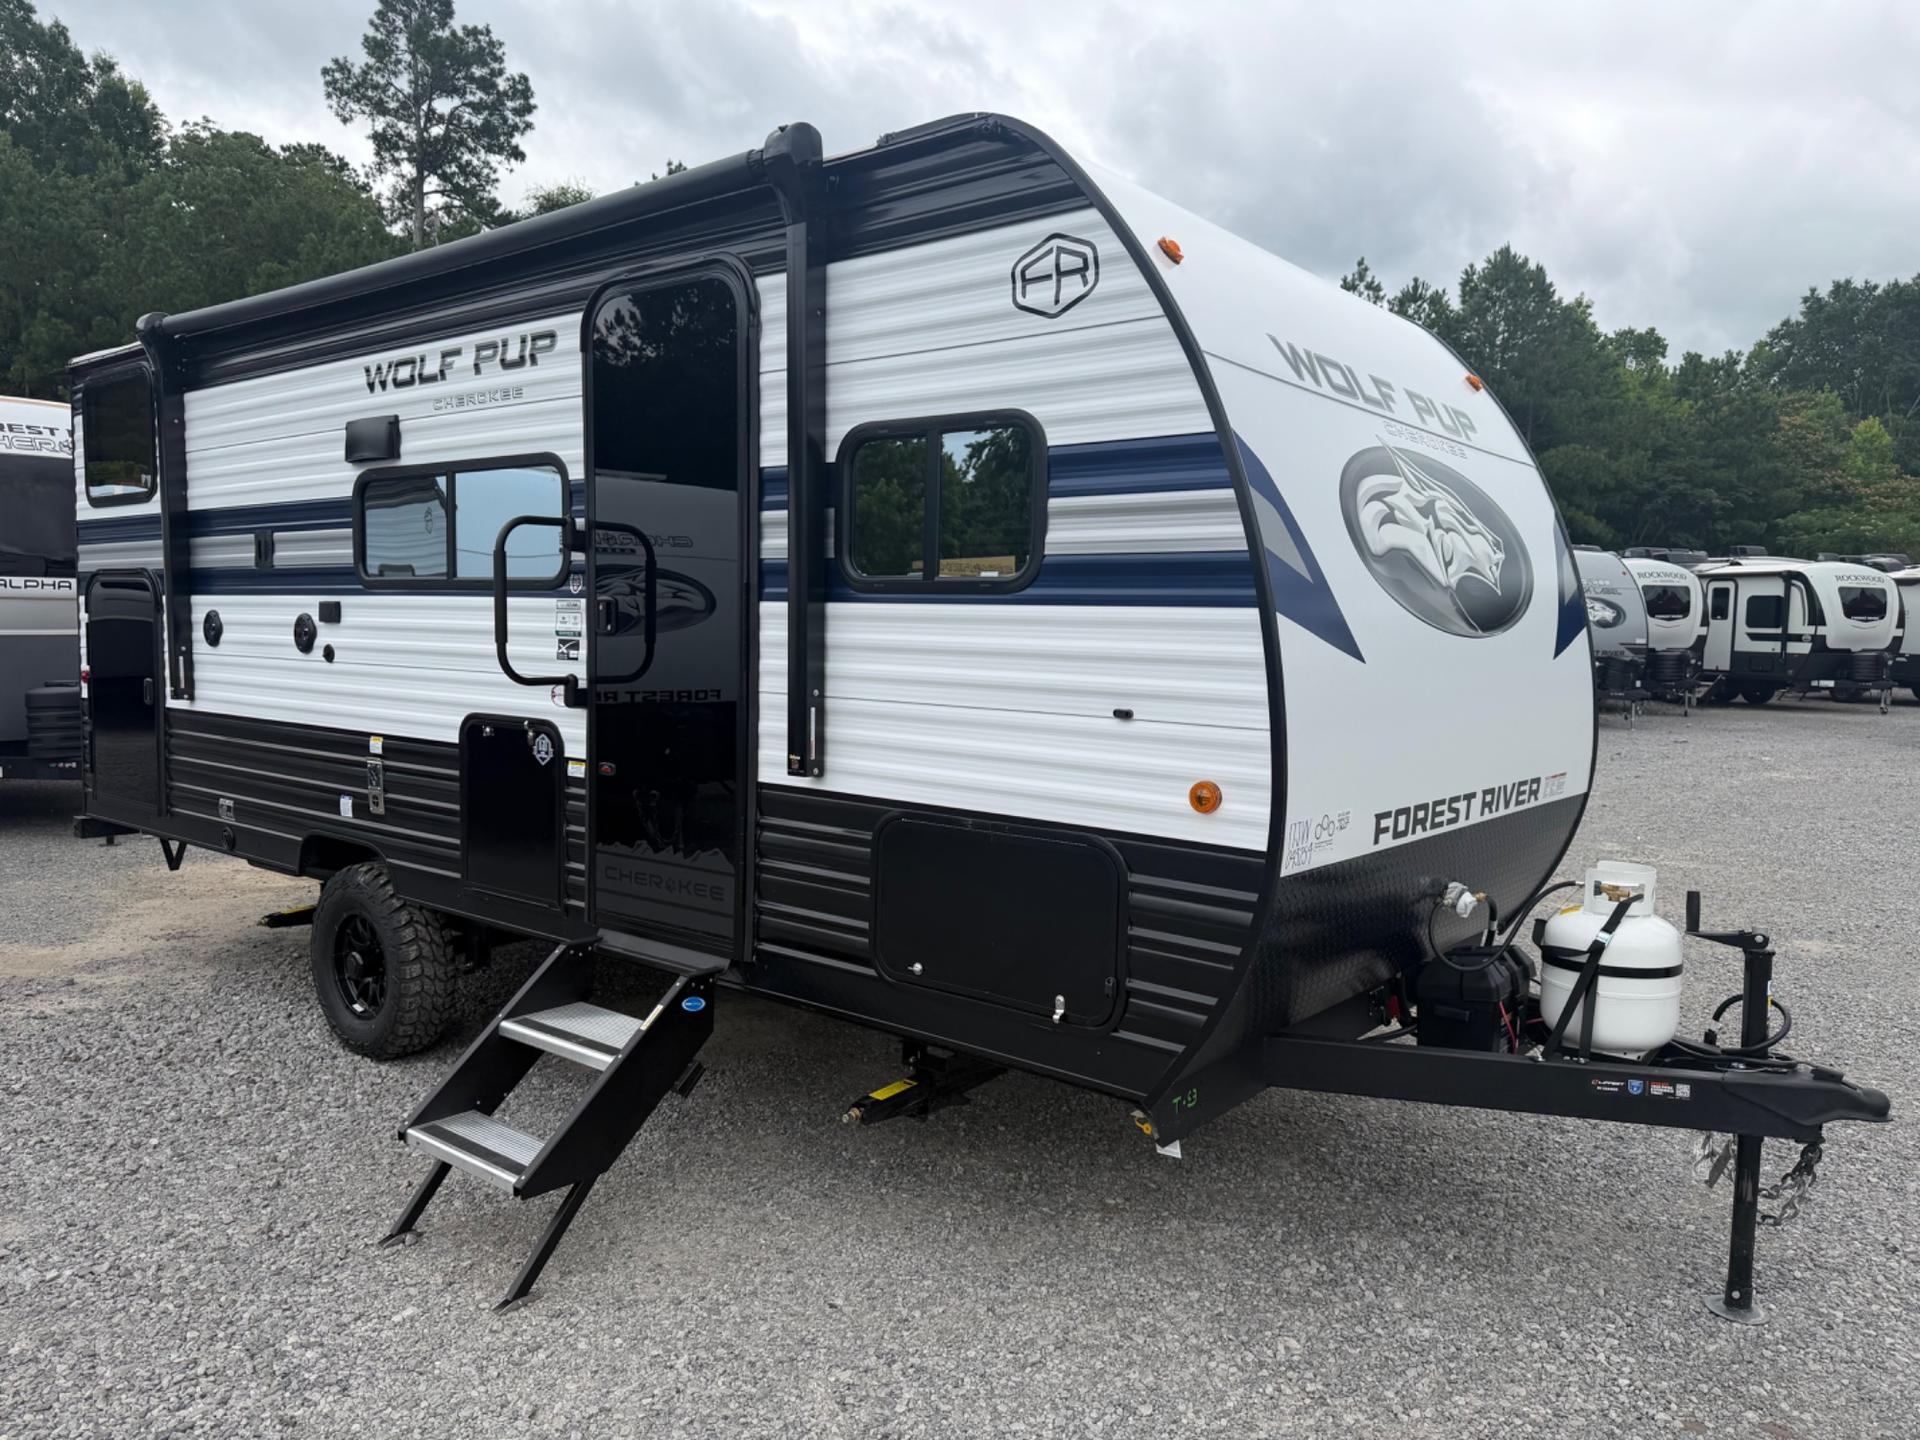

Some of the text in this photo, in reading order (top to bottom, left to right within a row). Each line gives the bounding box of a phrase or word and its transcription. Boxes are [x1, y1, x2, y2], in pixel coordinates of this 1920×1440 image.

[363, 329, 559, 394] WOLF PUP
[1265, 332, 1478, 442] WOLF PUP
[432, 385, 524, 411] CHEROKEE
[0, 423, 60, 436] EST
[1373, 791, 1477, 845] FOREST
[1480, 777, 1541, 817] RIVER
[604, 865, 725, 902] CHEROKEE
